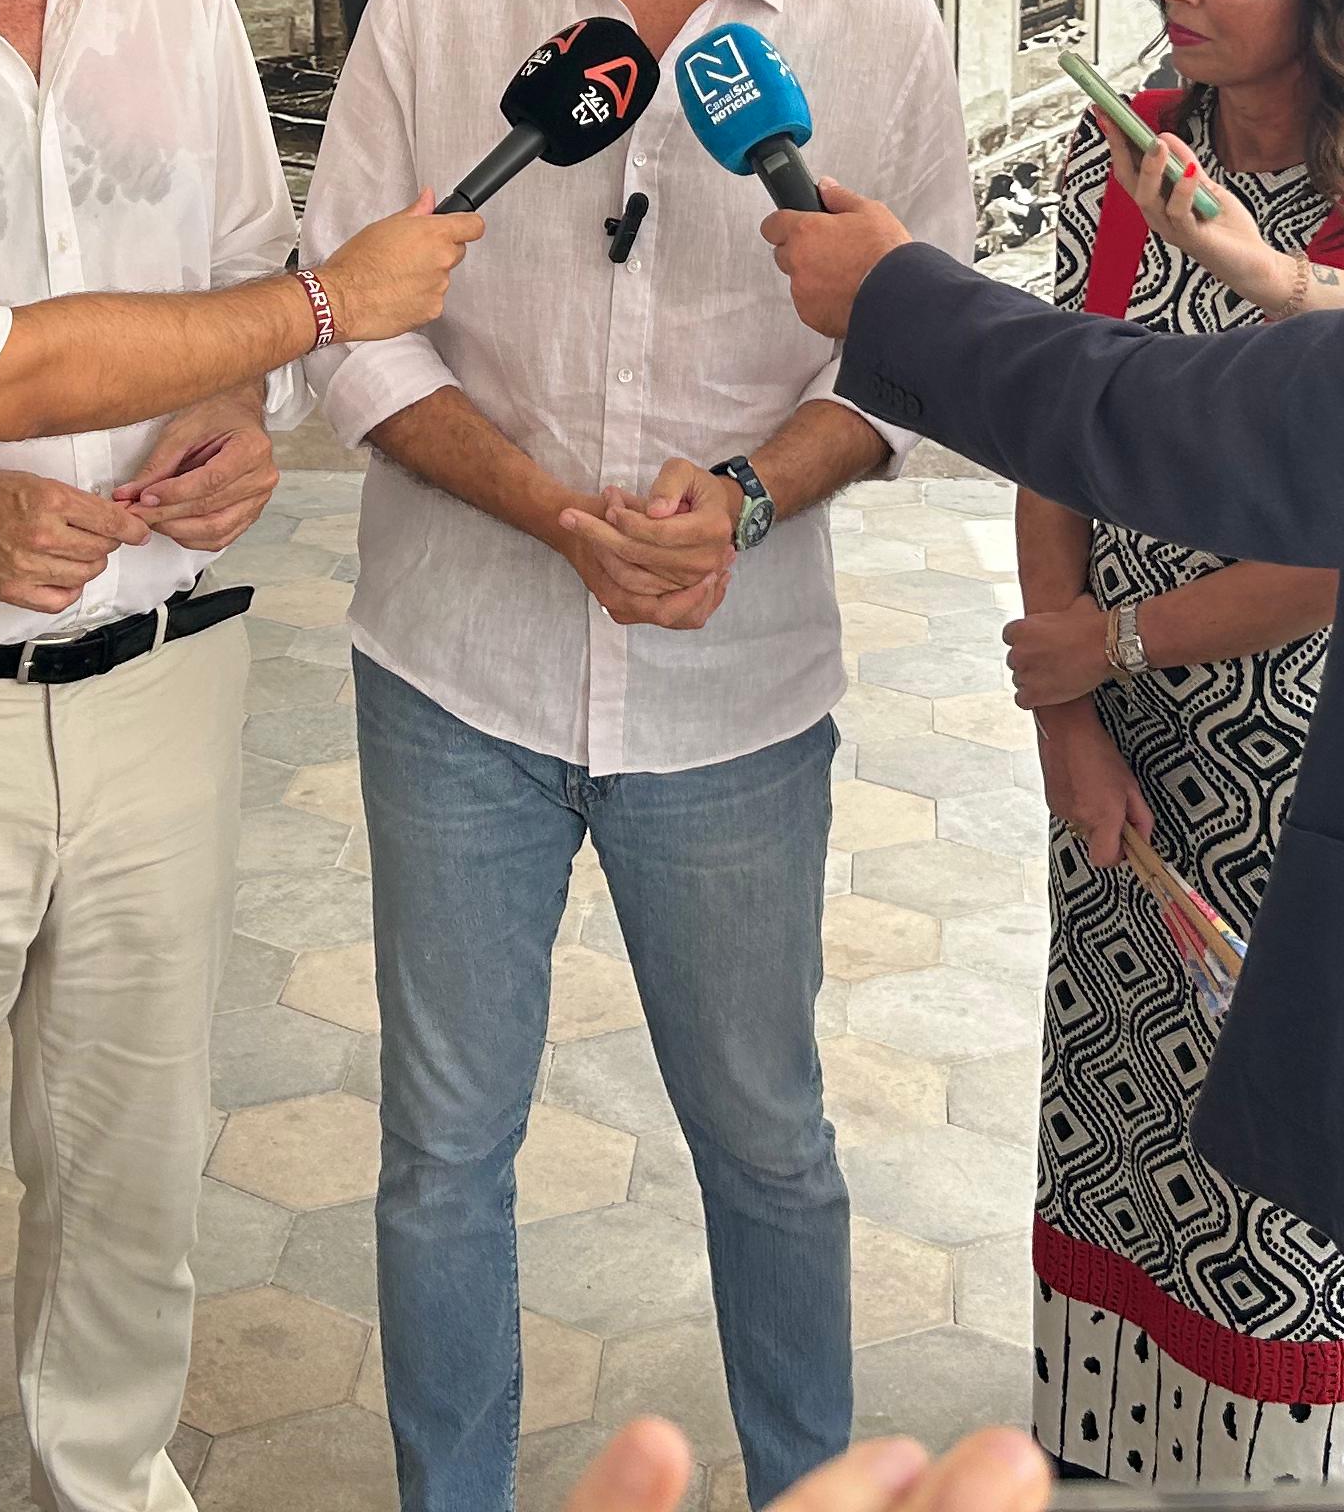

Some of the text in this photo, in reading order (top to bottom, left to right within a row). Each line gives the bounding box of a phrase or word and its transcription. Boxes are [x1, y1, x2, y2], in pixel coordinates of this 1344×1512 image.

[571, 101, 594, 126] tv
[584, 85, 610, 120] 24h
[710, 88, 761, 125] NOTICIAS
